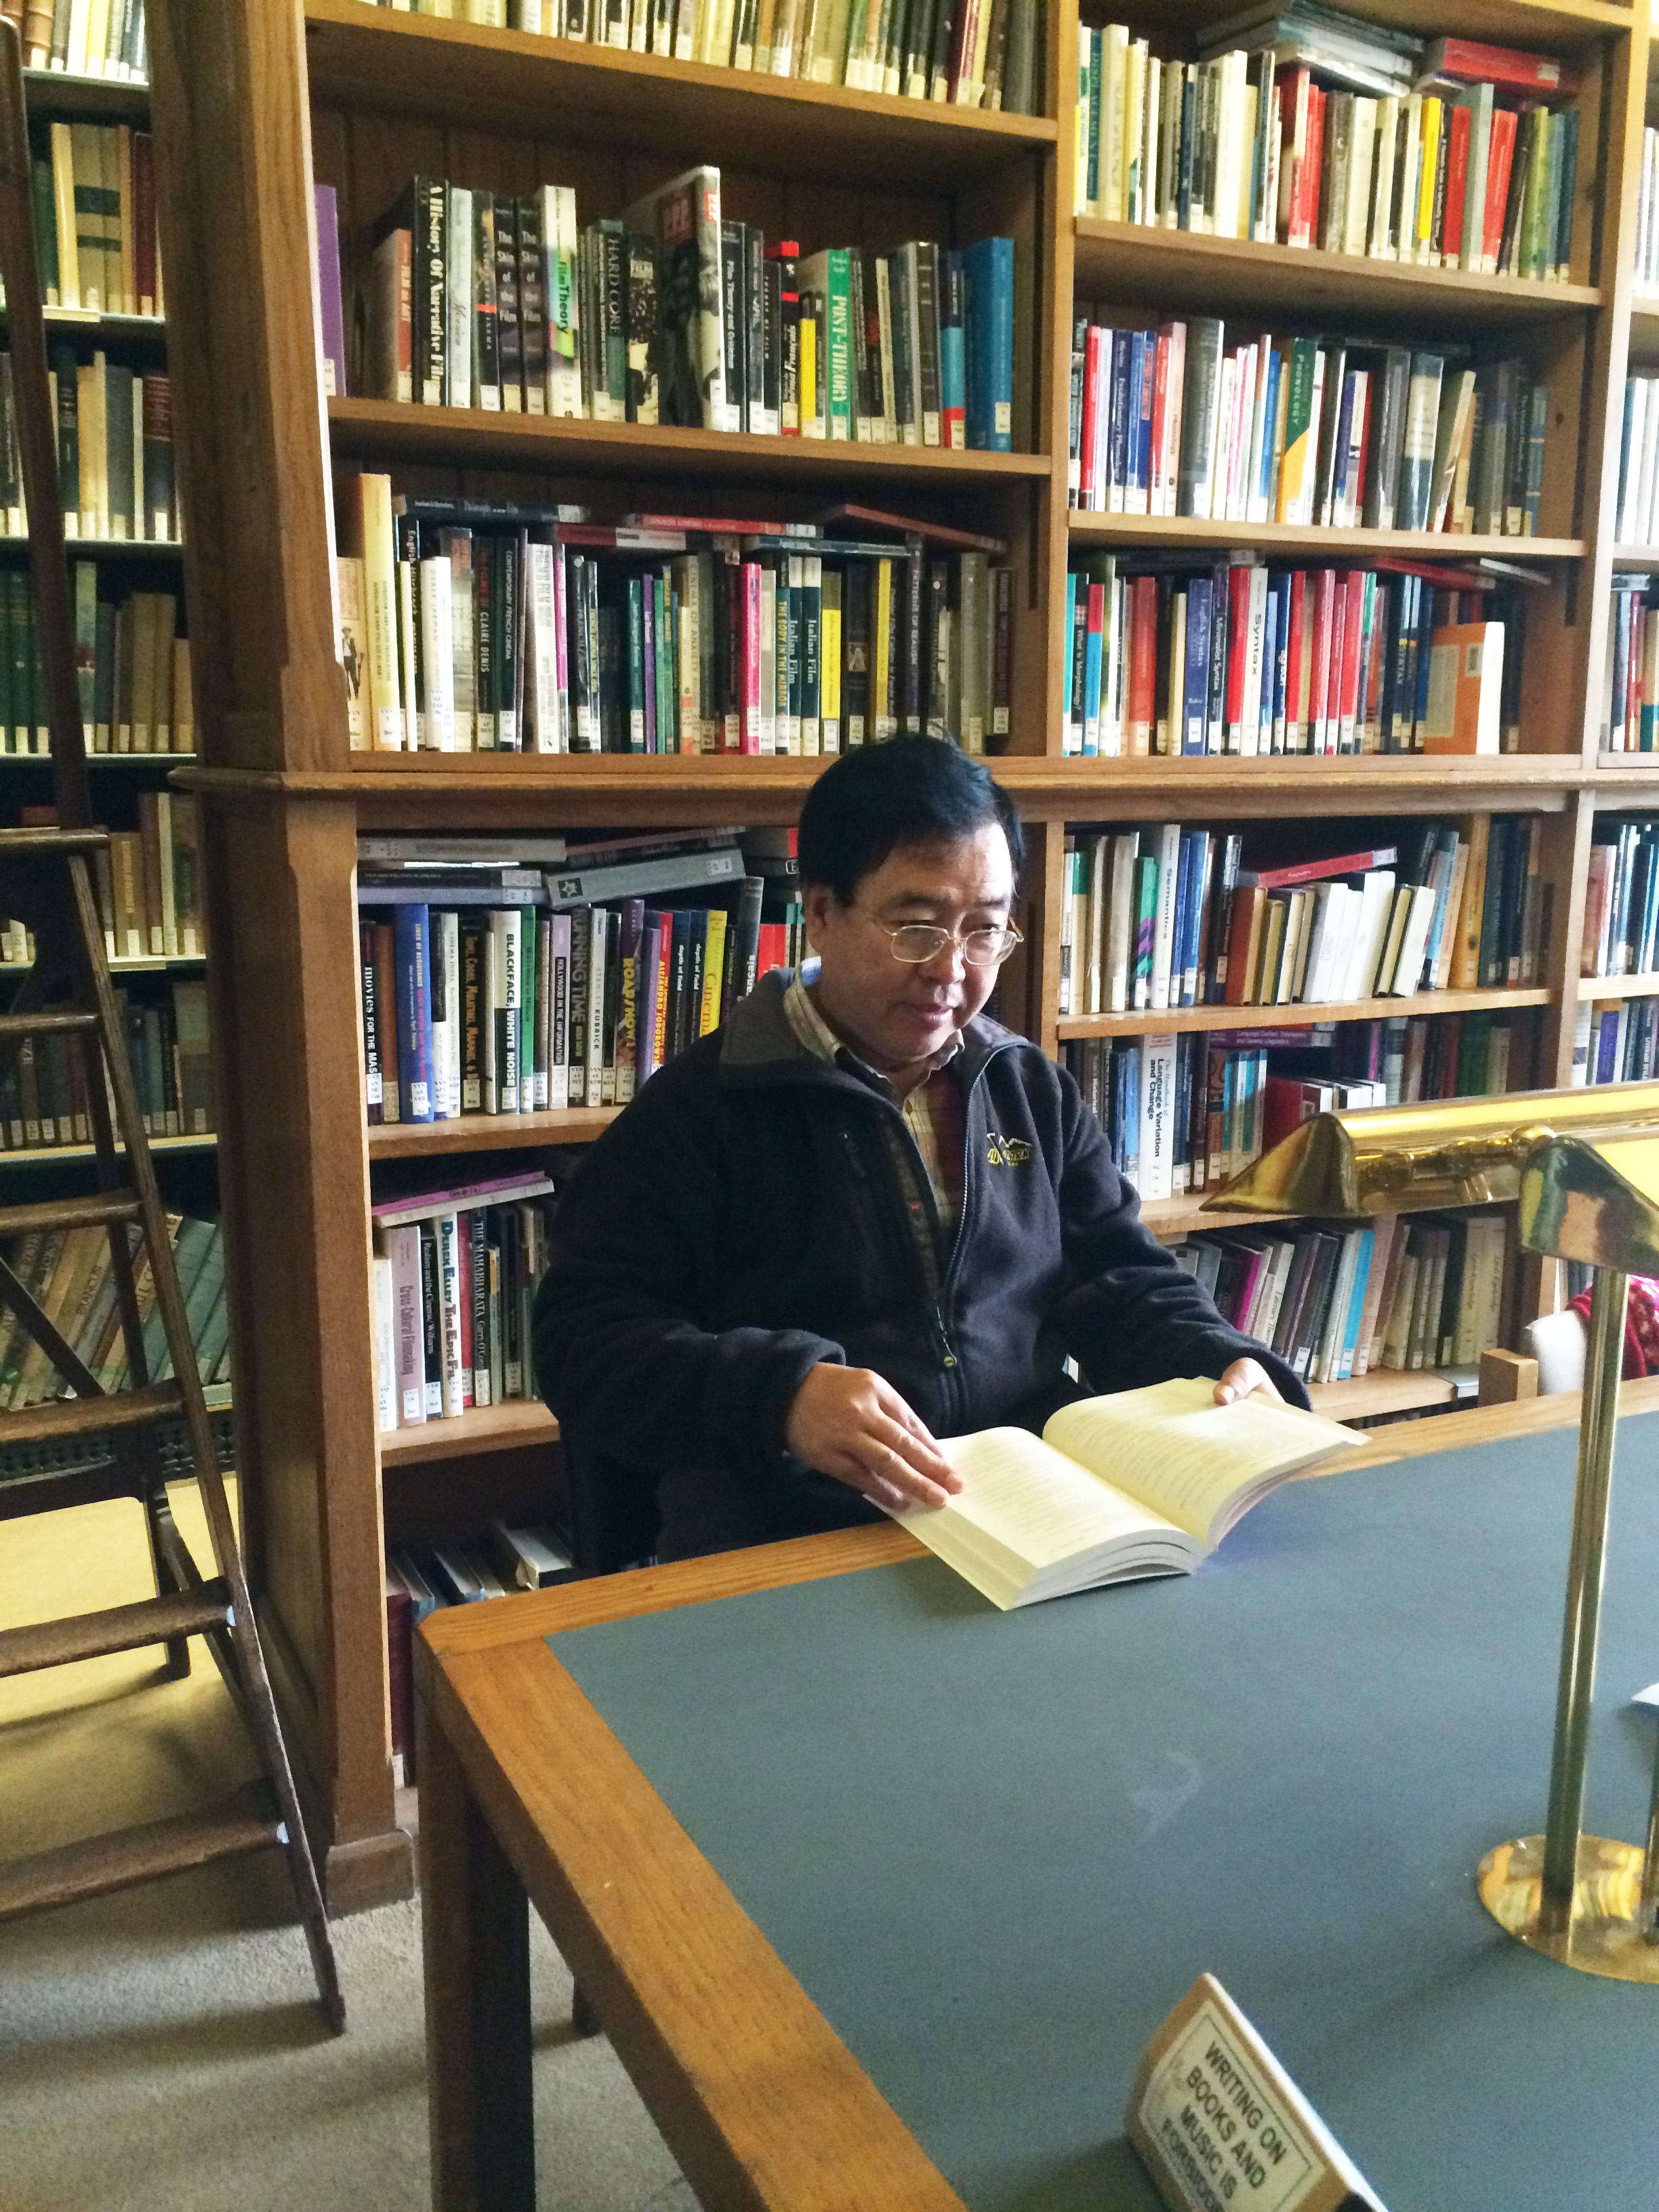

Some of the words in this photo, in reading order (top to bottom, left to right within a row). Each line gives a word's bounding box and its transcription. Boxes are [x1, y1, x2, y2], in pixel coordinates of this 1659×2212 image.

[430, 186, 444, 194] A
[427, 197, 444, 253] History
[497, 231, 512, 244] The
[521, 231, 537, 244] The
[430, 259, 443, 279] Of
[497, 250, 515, 263] Skin
[521, 250, 539, 262] Skin
[608, 239, 619, 287] HARD
[727, 261, 735, 280] Film
[503, 272, 511, 282] of
[527, 272, 535, 282] of
[609, 289, 620, 334] CORE
[727, 282, 735, 312] Theory
[430, 283, 443, 351] Narrative
[499, 311, 518, 323] Film
[524, 310, 541, 323] Film
[832, 295, 848, 402] POST-THEORY
[1115, 377, 1126, 432] Evolutionary
[1292, 354, 1305, 425] PHONOLOGY
[407, 530, 416, 564] English
[691, 565, 699, 607] CINEMA
[912, 569, 920, 612] PATTERNS
[691, 611, 699, 625] OF
[778, 601, 787, 617] THE
[912, 615, 920, 626] OF
[480, 611, 489, 643] CLAIRE
[778, 619, 787, 642] BODY
[789, 620, 798, 655] Italian
[808, 619, 817, 655] Italian
[1077, 630, 1085, 650] What
[1214, 617, 1224, 661] Minimalist
[480, 646, 489, 672] DENIS
[505, 634, 513, 659] CINEMA
[691, 629, 700, 672] ANXIETY
[777, 644, 787, 654] IN
[911, 630, 919, 665] REALISM
[1252, 613, 1262, 676] Syntax
[778, 656, 787, 672] THE
[789, 659, 798, 684] Film
[808, 659, 817, 684] Film
[1213, 662, 1222, 691] Syntax
[777, 674, 787, 707] MIRROR
[1073, 661, 1084, 710] Morphology?
[1163, 867, 1173, 939] Semantics
[572, 909, 588, 983] RUNNING
[505, 933, 515, 1008] BLACKFACE,
[557, 959, 565, 998] HOLLYWOOD
[657, 961, 665, 1010] ALEJANDRO
[678, 966, 684, 975] of
[695, 965, 701, 973] of
[364, 966, 376, 1013] movies
[571, 985, 588, 1023] TIME
[623, 957, 637, 1047] ROADSHOW!
[700, 973, 718, 1038] Cinema
[367, 1017, 375, 1033] FOR
[506, 1010, 515, 1048] WHITE
[556, 1008, 565, 1020] THE
[556, 1021, 564, 1065] INFORMATION
[507, 1052, 516, 1086] NOISE
[1149, 1059, 1158, 1078] and
[1155, 1058, 1165, 1109] Language
[1147, 1081, 1157, 1120] Change
[1154, 1111, 1164, 1157] Variation
[474, 1220, 485, 1241] THE
[424, 1242, 433, 1269] Realism
[425, 1269, 433, 1282] and
[425, 1282, 434, 1293] the
[474, 1243, 486, 1317] MAHABHARATA
[1270, 1290, 1282, 1320] Literary
[428, 1324, 436, 1354] Williams
[476, 1319, 486, 1342] Garry
[401, 1335, 416, 1375] Filmmaking
[1205, 2041, 1264, 2129] WRITING
[1259, 2127, 1288, 2165] ON
[1186, 2066, 1237, 2142] BOOKS
[1230, 2139, 1266, 2190] AND
[1181, 2104, 1223, 2175] MUSIC
[1219, 2170, 1237, 2200] IS
